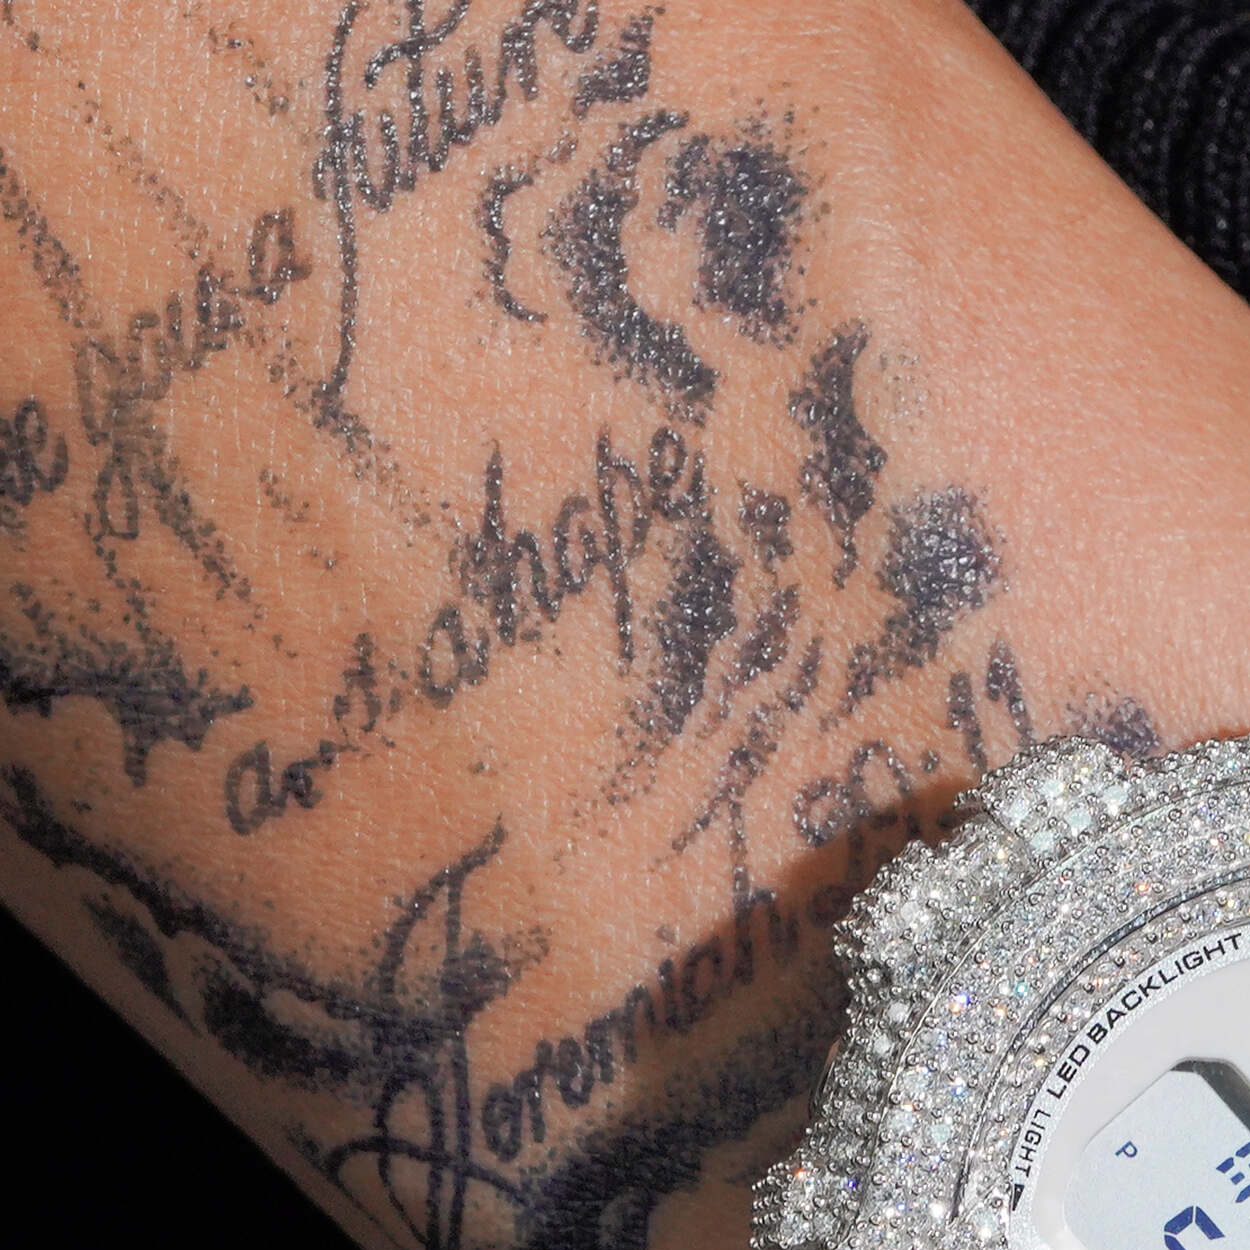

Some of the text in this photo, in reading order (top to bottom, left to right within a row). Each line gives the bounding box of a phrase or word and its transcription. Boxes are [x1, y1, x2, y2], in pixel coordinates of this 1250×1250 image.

[1047, 932, 1243, 1100] LED BACKLIGHT
[1014, 1109, 1052, 1178] LIGHT
[1115, 1140, 1138, 1158] P
